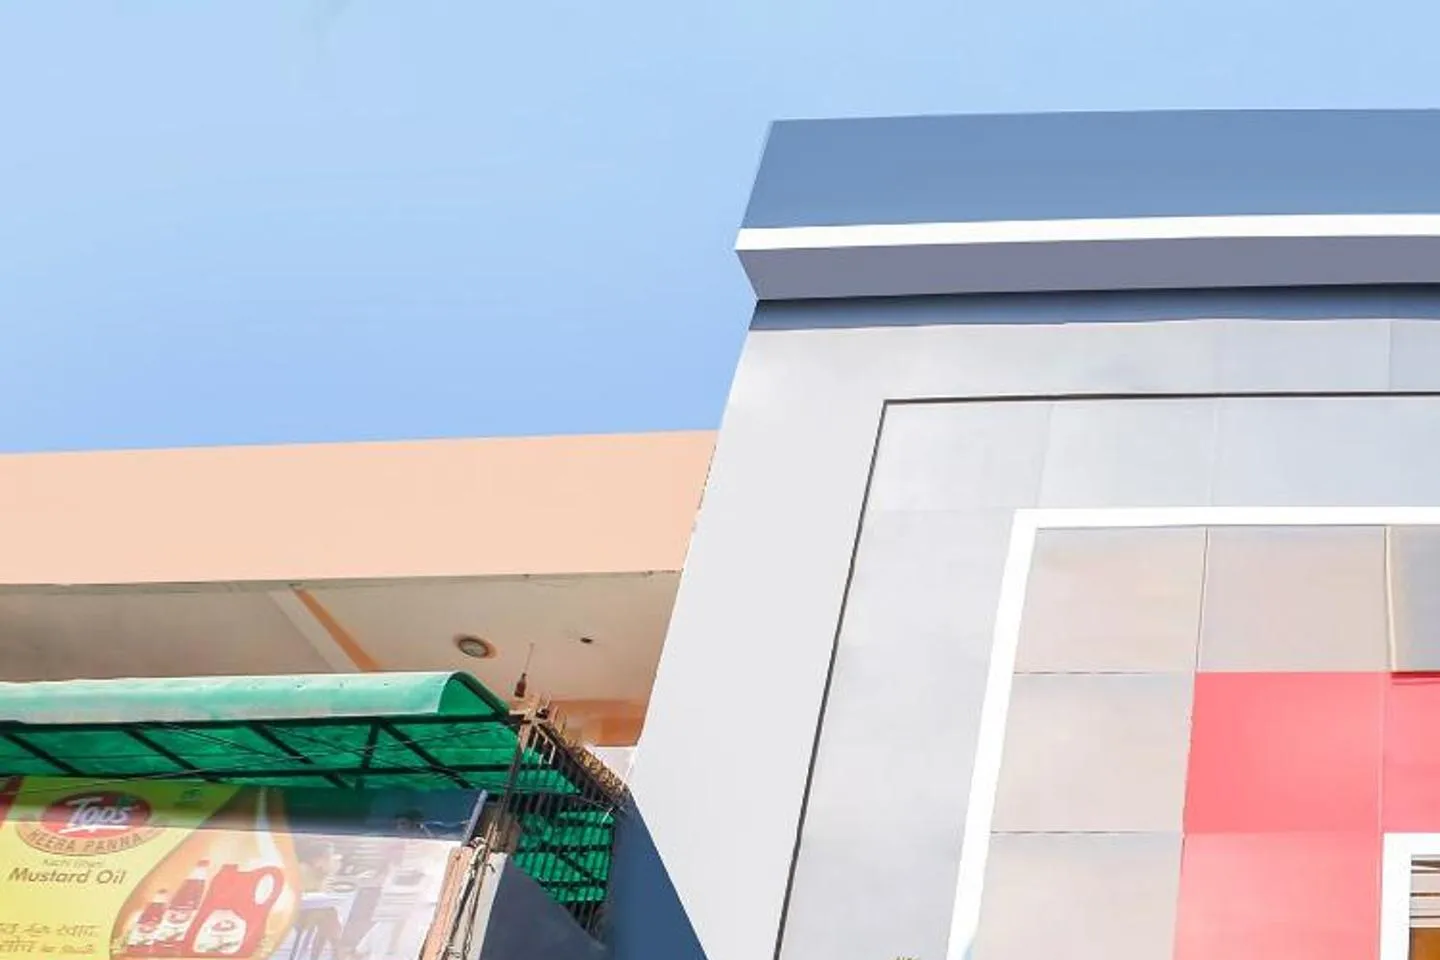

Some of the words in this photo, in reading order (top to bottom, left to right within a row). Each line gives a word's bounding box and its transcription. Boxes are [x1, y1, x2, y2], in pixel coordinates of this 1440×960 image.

[84, 832, 143, 851] PANNA
[8, 867, 91, 883] Mustard
[97, 869, 126, 885] Oil
